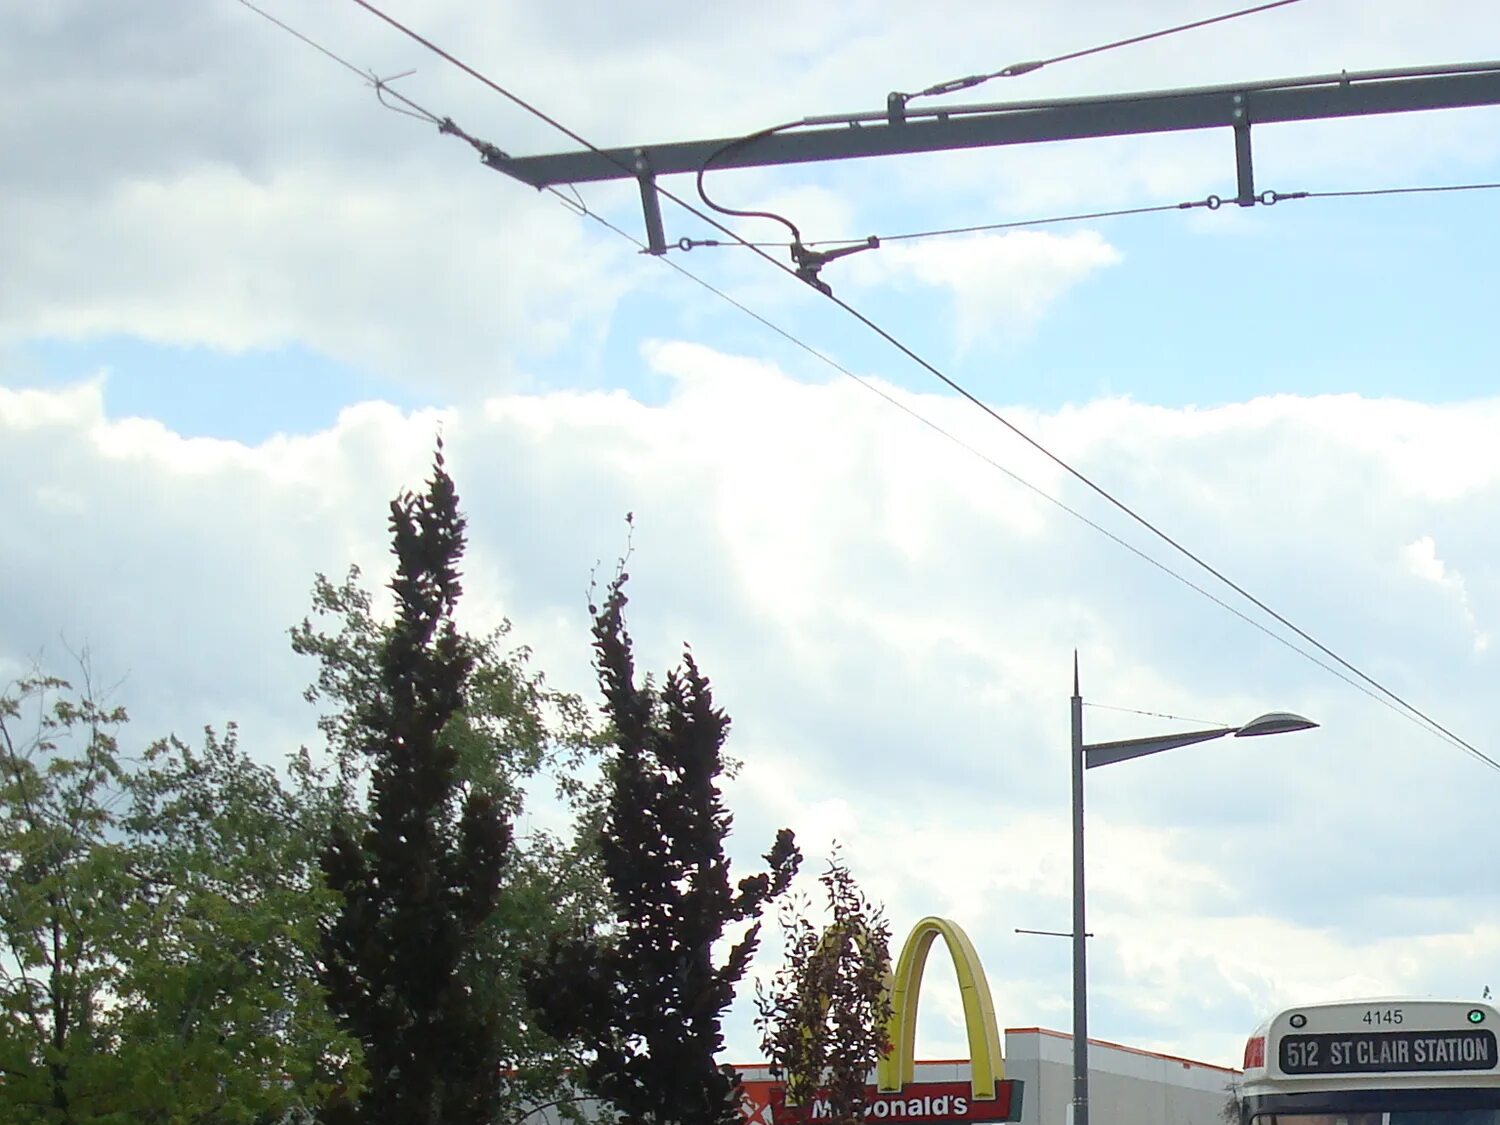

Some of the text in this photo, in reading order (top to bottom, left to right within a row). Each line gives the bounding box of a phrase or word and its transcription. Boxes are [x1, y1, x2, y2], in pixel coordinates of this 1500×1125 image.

[1363, 1010, 1403, 1025] 4145
[1287, 1037, 1488, 1067] 512 ST CLAIR STATION
[811, 1095, 968, 1119] Monald's
